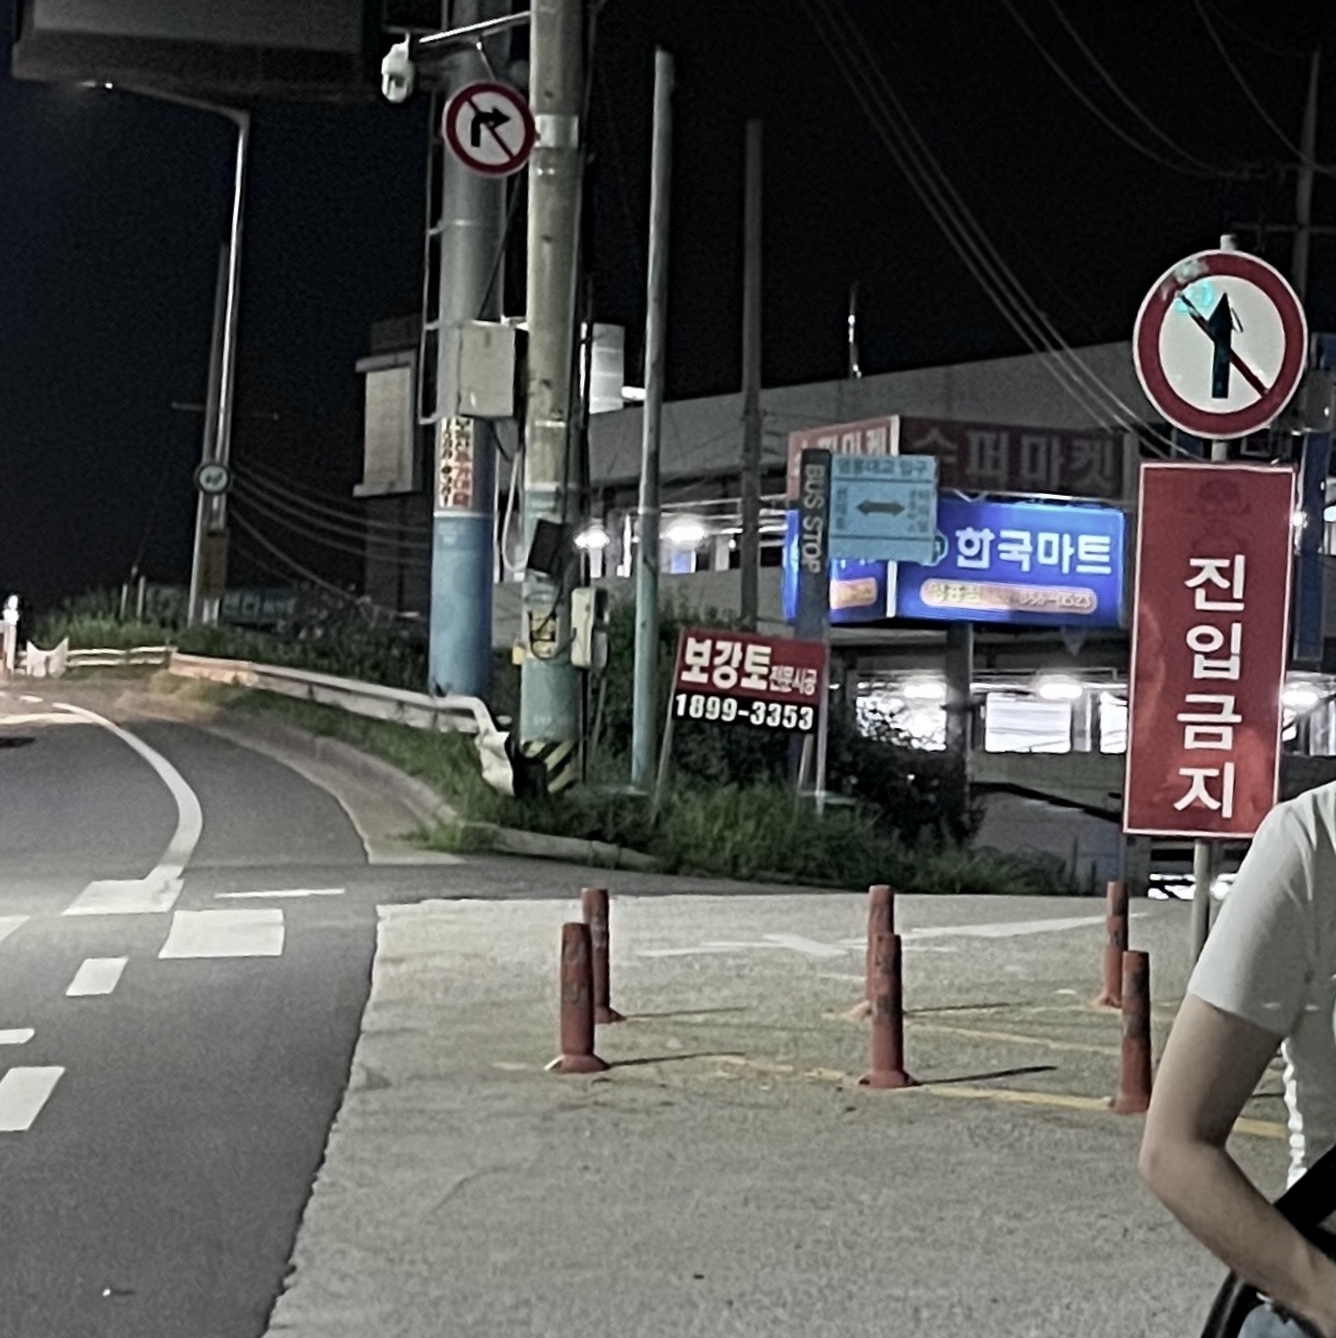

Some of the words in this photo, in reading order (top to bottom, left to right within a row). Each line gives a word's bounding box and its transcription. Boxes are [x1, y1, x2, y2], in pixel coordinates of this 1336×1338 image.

[804, 464, 826, 509] BUS
[802, 516, 823, 574] STOP
[955, 527, 1112, 575] 한국마트
[681, 637, 772, 690] 보강토
[769, 665, 818, 695] 전문시공
[1173, 553, 1246, 819] 진입금지
[676, 693, 814, 731] 1899-3353
